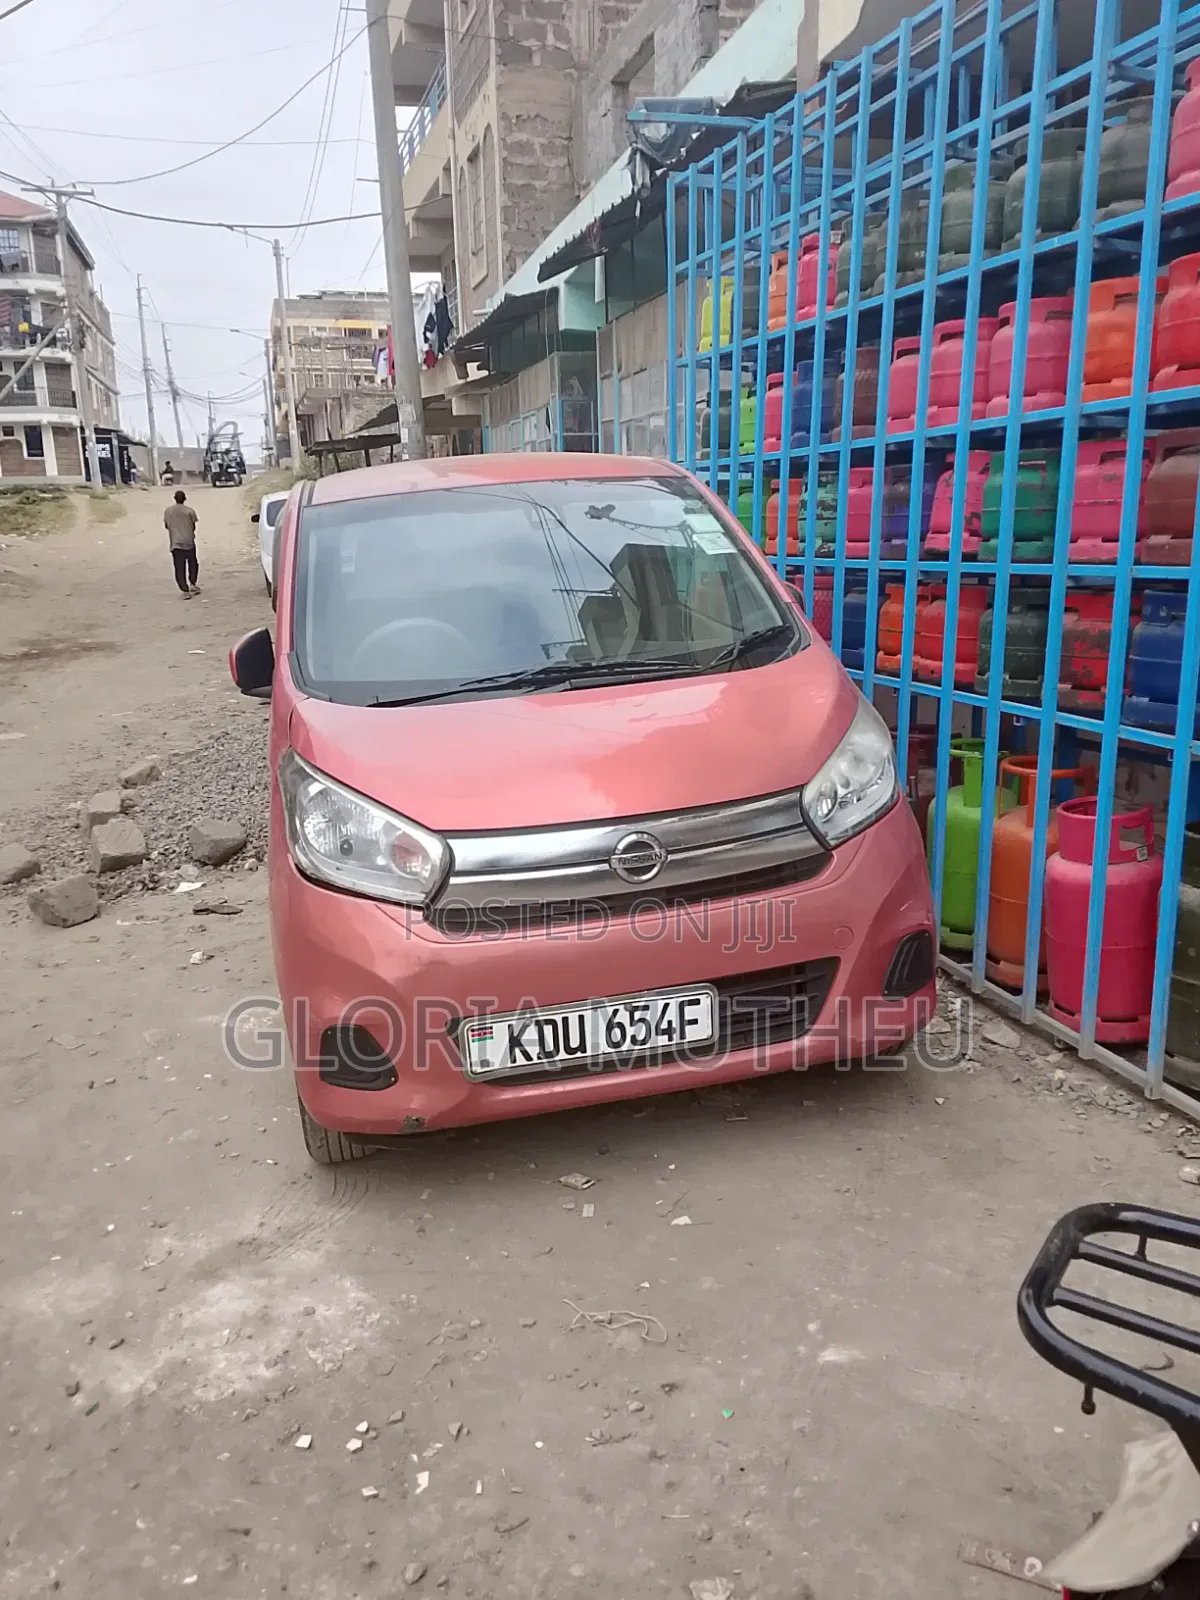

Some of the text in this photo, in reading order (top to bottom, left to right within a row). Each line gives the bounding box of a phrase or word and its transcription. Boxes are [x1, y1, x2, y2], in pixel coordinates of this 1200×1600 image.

[618, 852, 662, 865] NISSAN
[507, 997, 702, 1064] KDU 654F
